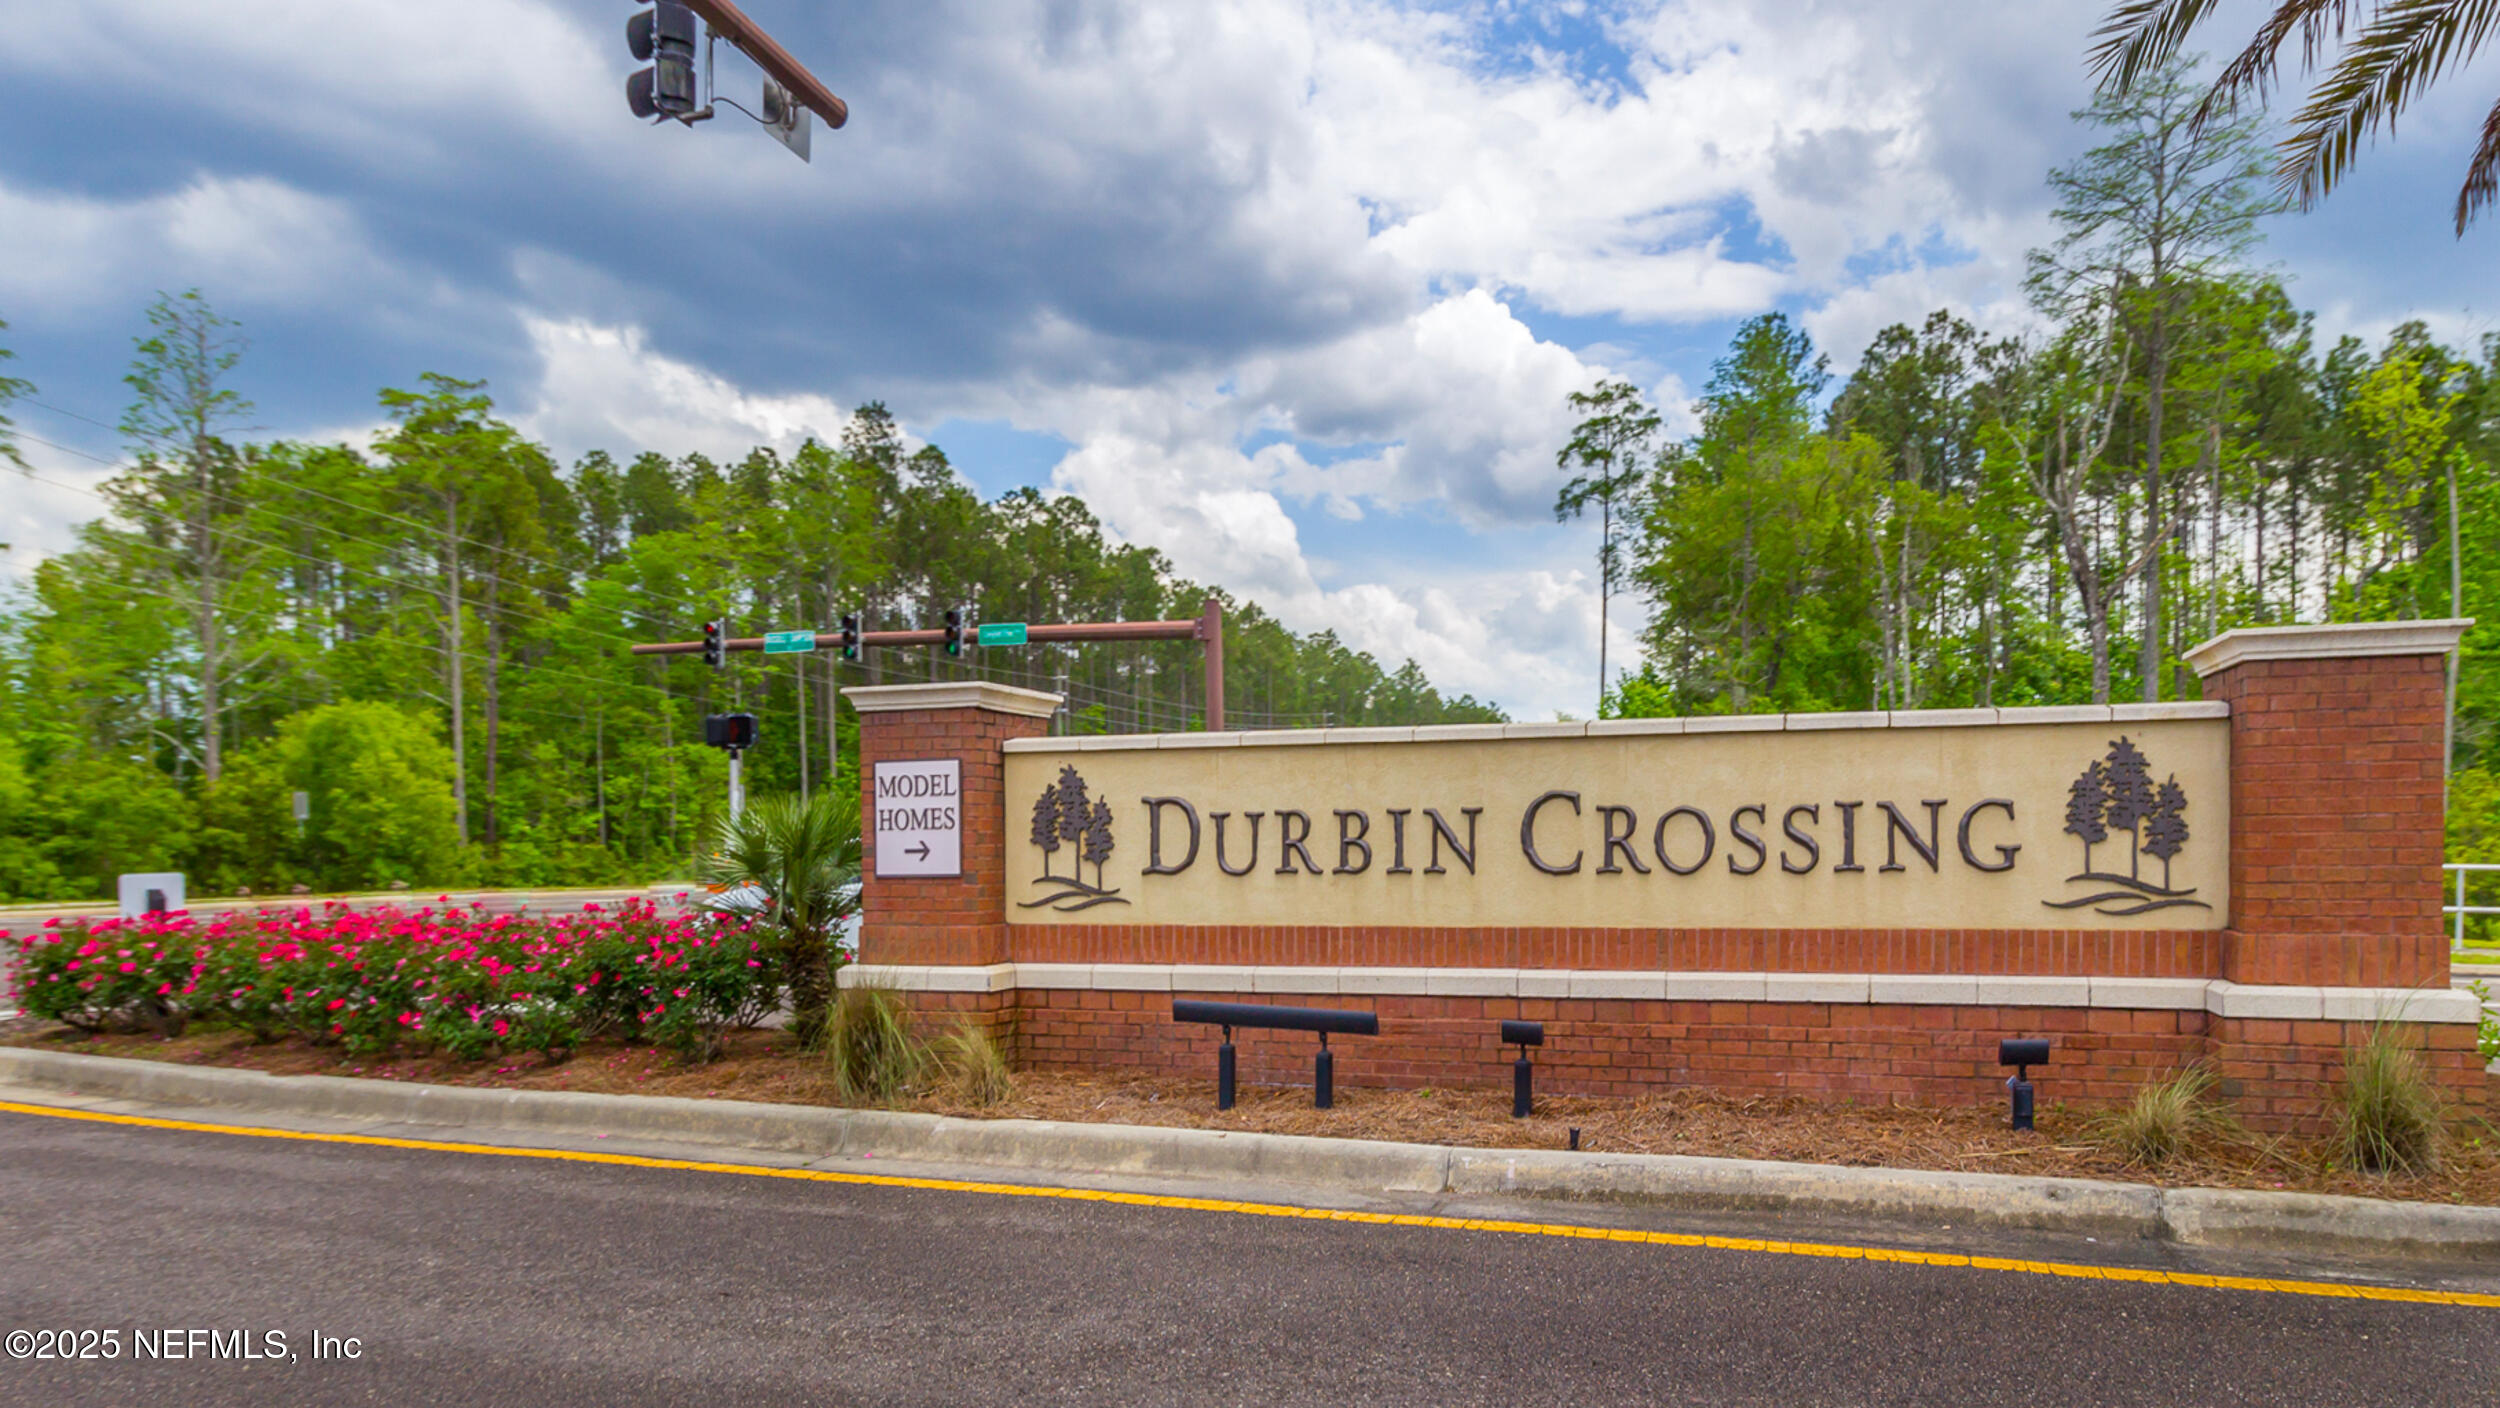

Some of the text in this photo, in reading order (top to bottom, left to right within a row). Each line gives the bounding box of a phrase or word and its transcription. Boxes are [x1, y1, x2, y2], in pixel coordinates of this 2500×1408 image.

[878, 774, 957, 798] MODEL
[878, 807, 956, 831] HOMES
[1141, 790, 2022, 876] DURBIN CROSSING
